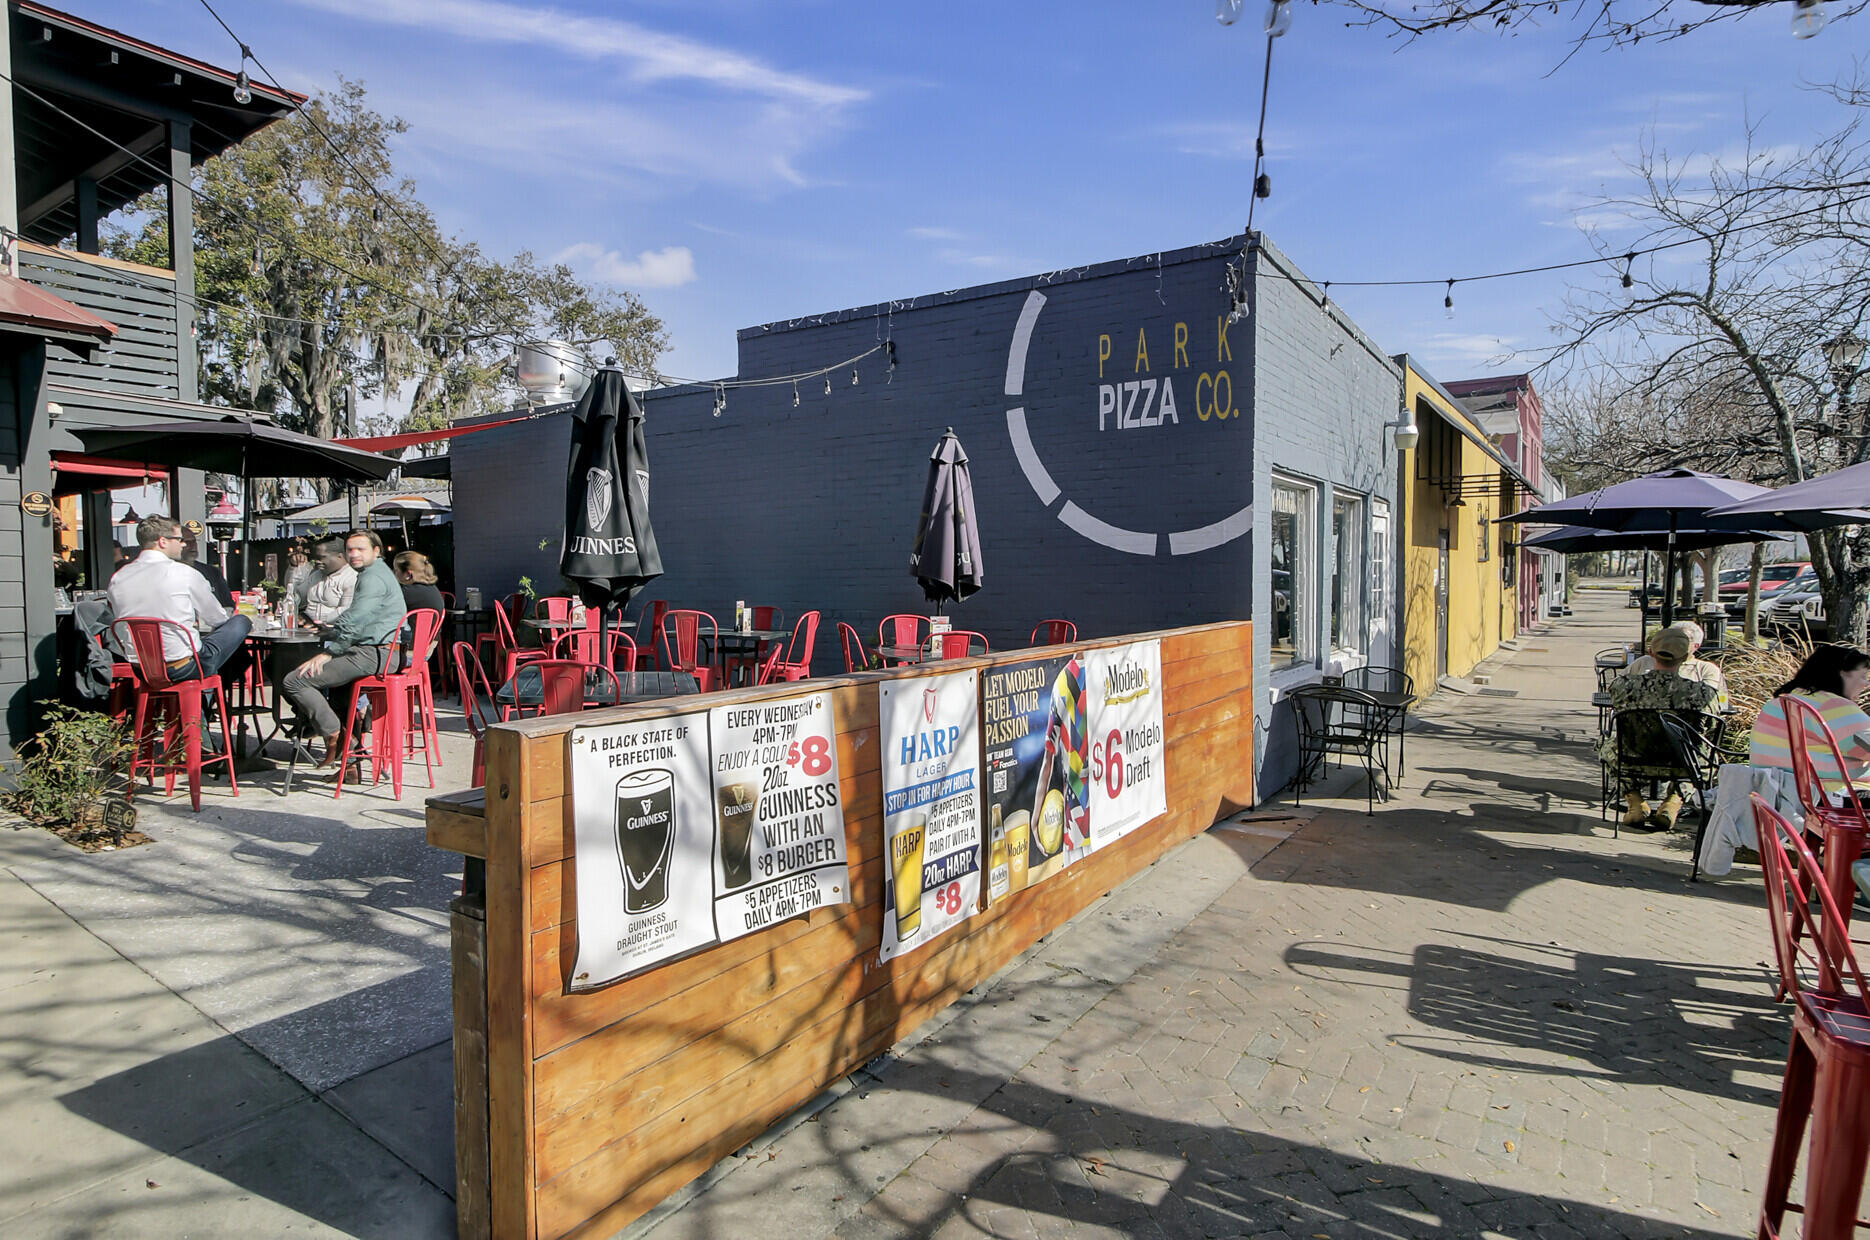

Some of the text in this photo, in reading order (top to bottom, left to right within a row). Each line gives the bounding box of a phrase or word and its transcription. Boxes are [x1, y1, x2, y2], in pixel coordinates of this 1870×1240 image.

[1099, 315, 1232, 378] PARK
[1099, 370, 1239, 431] PIZZA CO.
[570, 536, 638, 555] UINNES
[985, 666, 1046, 699] LET MODELO
[1108, 662, 1144, 696] Modelo
[727, 708, 761, 729] EVERY
[985, 690, 1040, 723] FUEL YOUR
[590, 726, 689, 753] A BLACK STATE OF
[900, 725, 960, 766] HARP
[985, 714, 1029, 746] PASSION
[1126, 721, 1161, 755] Modelo
[609, 745, 677, 768] PERFECTION.
[718, 744, 787, 772] ENJOY A COLD
[786, 735, 832, 777] $8
[916, 762, 947, 778] LAGER
[1092, 728, 1124, 799] $6
[1126, 755, 1151, 788] Draft
[759, 782, 838, 822] GUINNESS
[888, 773, 970, 812] STOP IN FOR HAPPY HOUR
[939, 792, 973, 816] APPETIZERS
[627, 811, 669, 830] GUINNESS
[762, 813, 825, 849] WITH AN
[929, 808, 976, 836] DAILY 4PM-7PM
[758, 838, 836, 877] $8 BURGER
[896, 831, 921, 858] HARP
[929, 826, 976, 857] PAIR IT WITH A
[946, 850, 973, 879] HARP
[745, 873, 817, 909] $5 APPETIZERS
[935, 881, 962, 915] $8
[628, 912, 666, 933] GUINNESS
[744, 889, 822, 930] DAILY 4PM-7PM
[617, 929, 653, 951] DRAUGHT
[655, 920, 678, 936] STOUT
